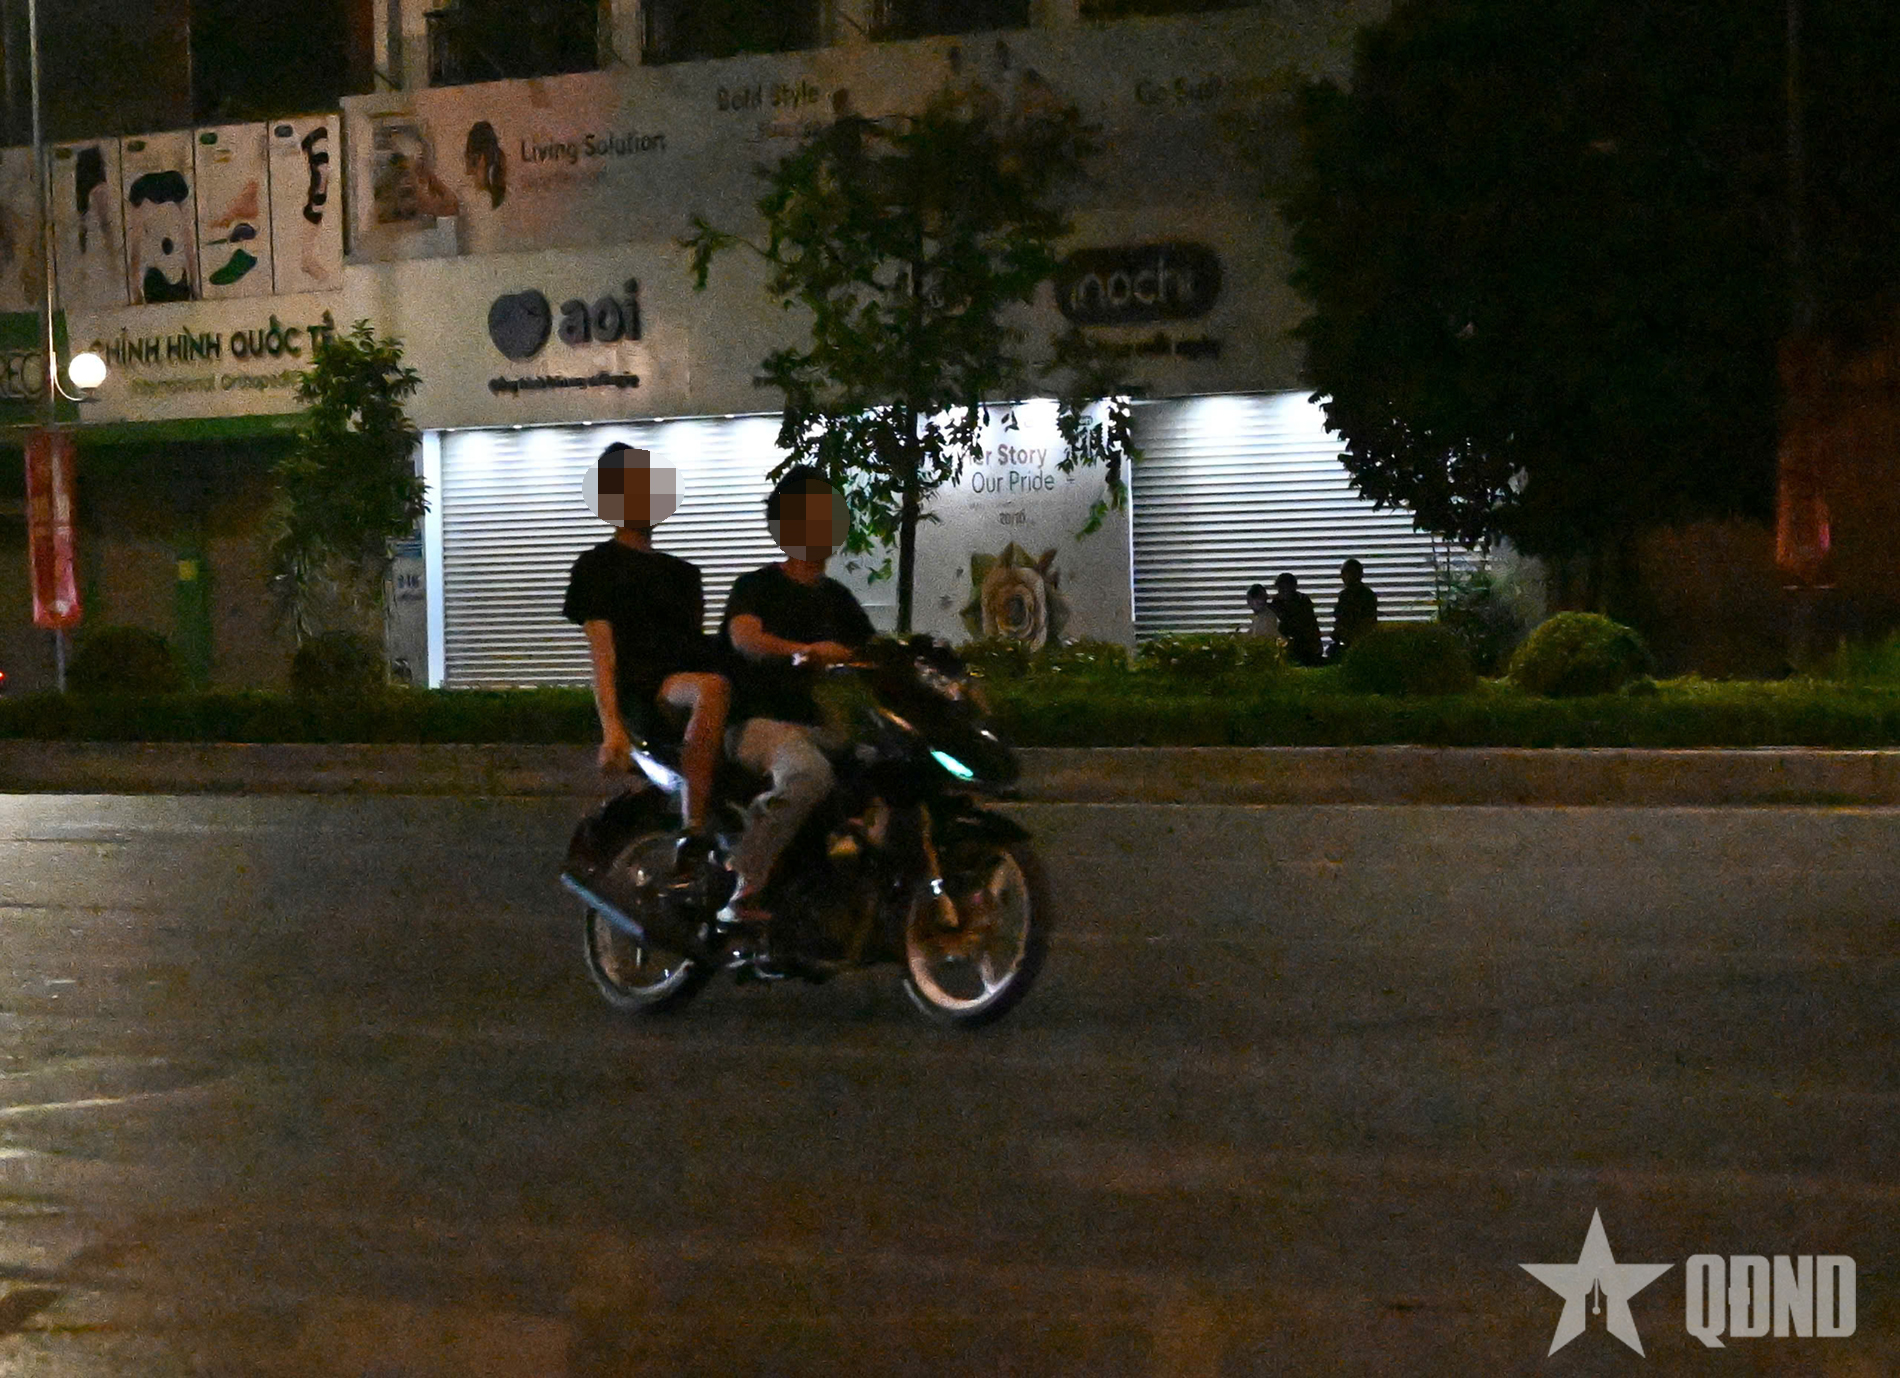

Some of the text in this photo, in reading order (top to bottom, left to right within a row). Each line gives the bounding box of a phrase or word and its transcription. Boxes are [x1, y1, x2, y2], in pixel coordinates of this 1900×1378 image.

[521, 132, 666, 165] Living Solution
[558, 278, 640, 345] aoi
[167, 326, 221, 362] HÌNH
[998, 444, 1047, 468] Story
[972, 470, 1055, 494] Our Pride
